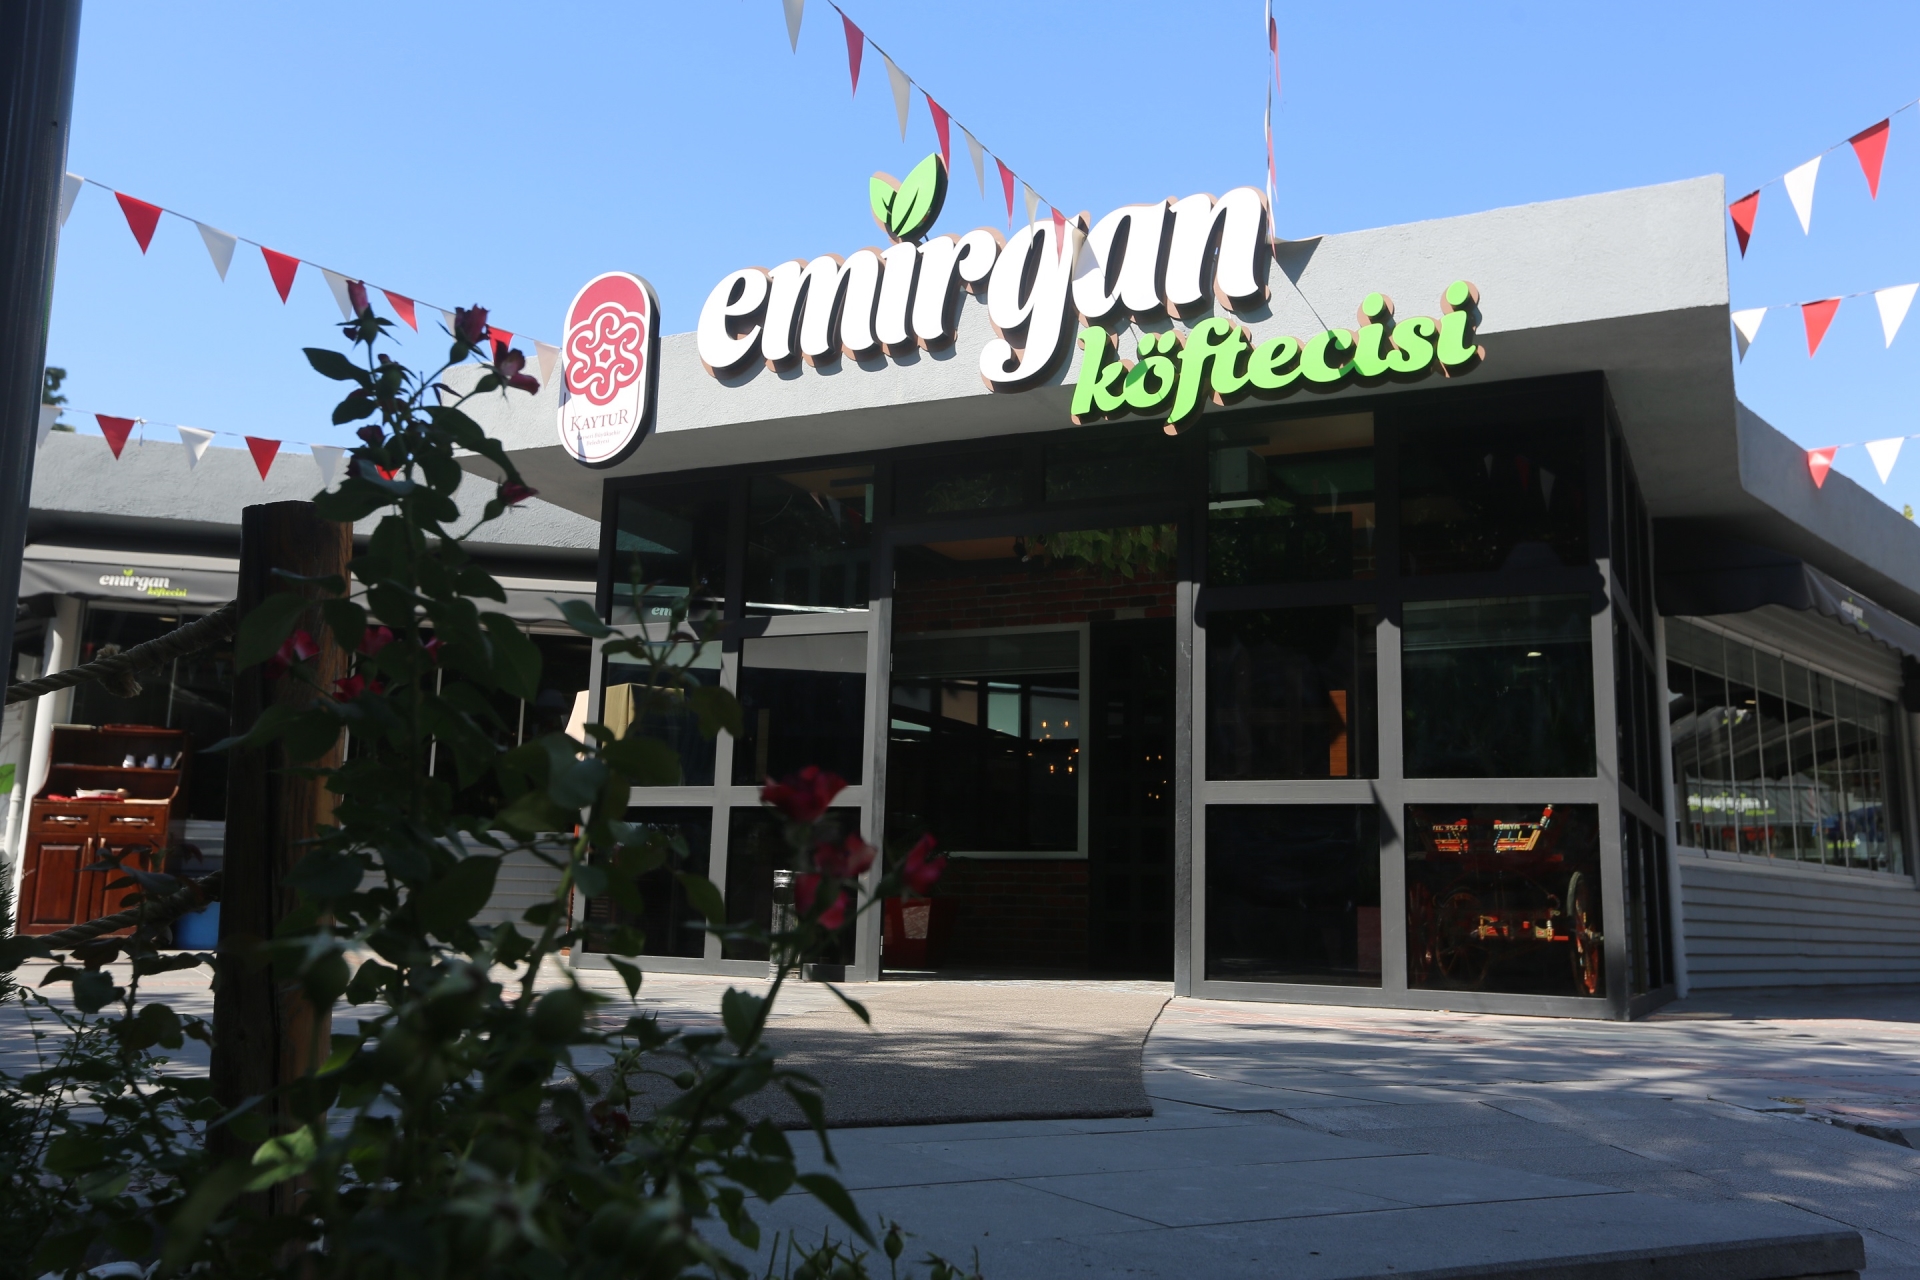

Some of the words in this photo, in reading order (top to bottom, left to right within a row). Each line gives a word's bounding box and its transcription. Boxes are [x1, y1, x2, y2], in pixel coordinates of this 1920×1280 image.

[696, 187, 1269, 383] emirgan
[1070, 279, 1478, 425] köftecisi
[570, 408, 629, 432] KAYTUR
[99, 574, 170, 591] emirgan
